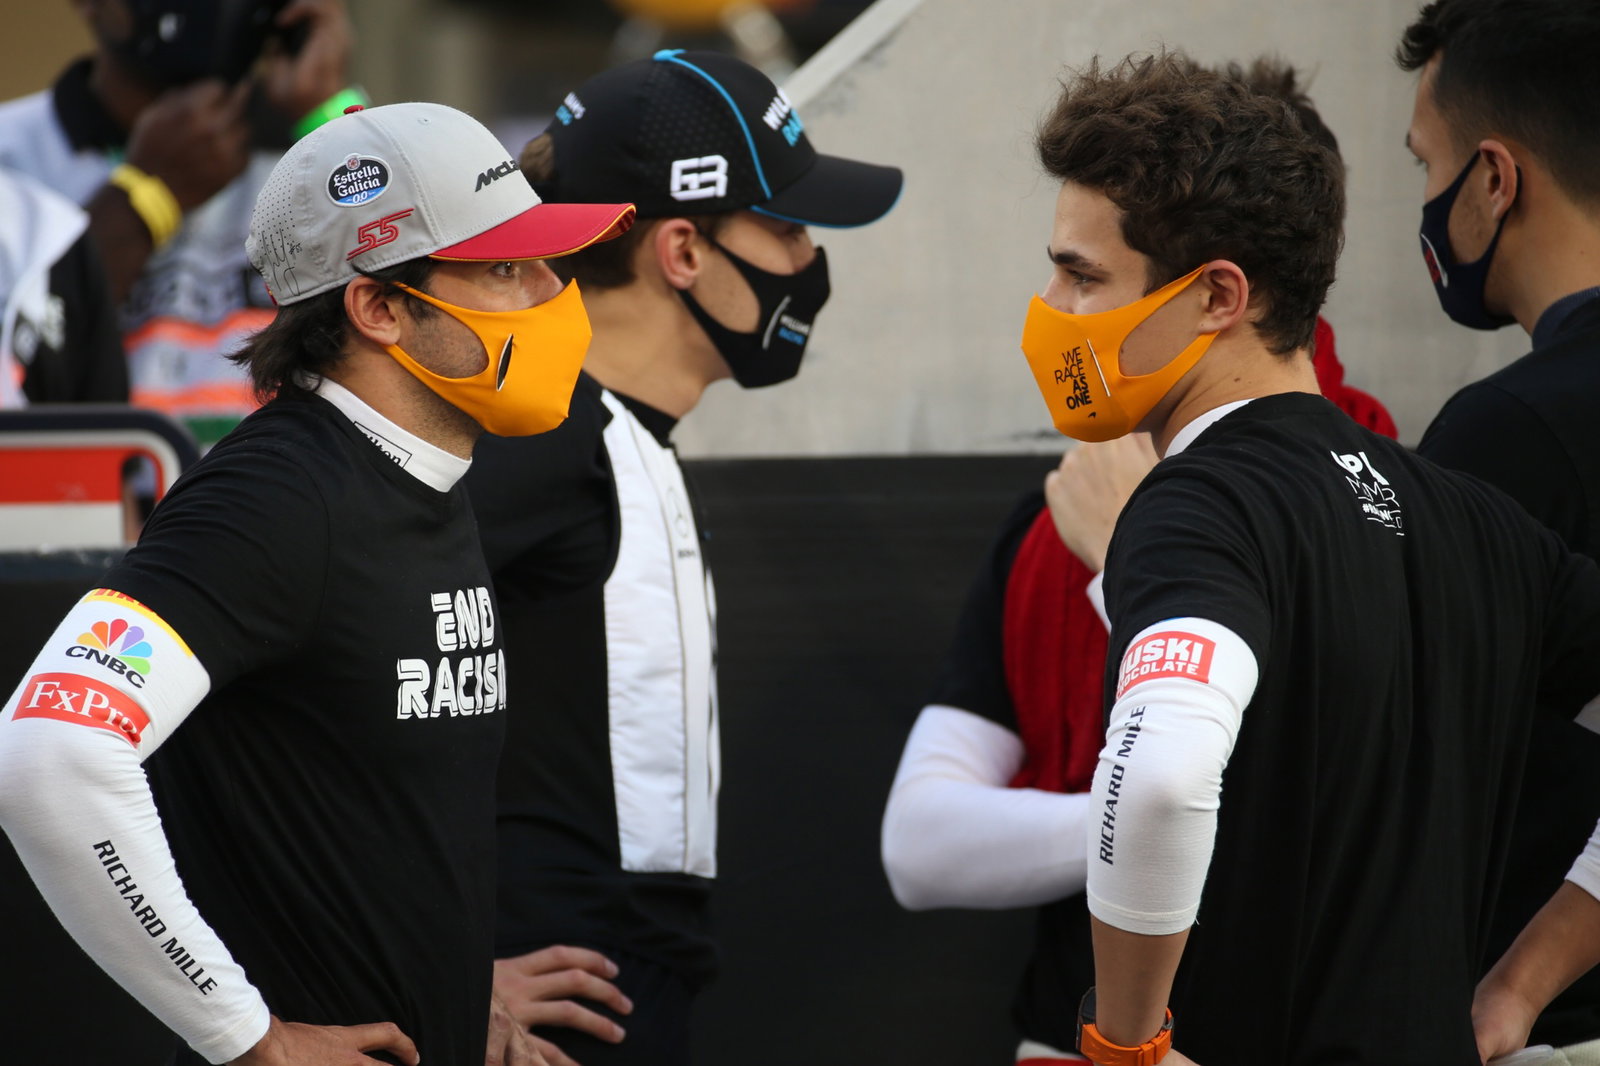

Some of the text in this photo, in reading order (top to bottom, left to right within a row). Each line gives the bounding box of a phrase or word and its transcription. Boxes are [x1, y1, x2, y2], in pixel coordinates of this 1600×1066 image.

[333, 165, 380, 187] Estrella
[338, 177, 381, 197] Galicia
[671, 155, 728, 201] 63
[346, 208, 414, 261] 55
[1054, 360, 1086, 384] RACE
[1062, 346, 1083, 365] WE
[1066, 389, 1092, 410] ONE
[1073, 376, 1089, 394] AS
[431, 586, 495, 652] END
[65, 645, 145, 688] CNBC
[25, 681, 138, 735] FxPro
[1099, 705, 1147, 866] RICHARD MILLE
[92, 839, 218, 996] RICHARD MILLE
